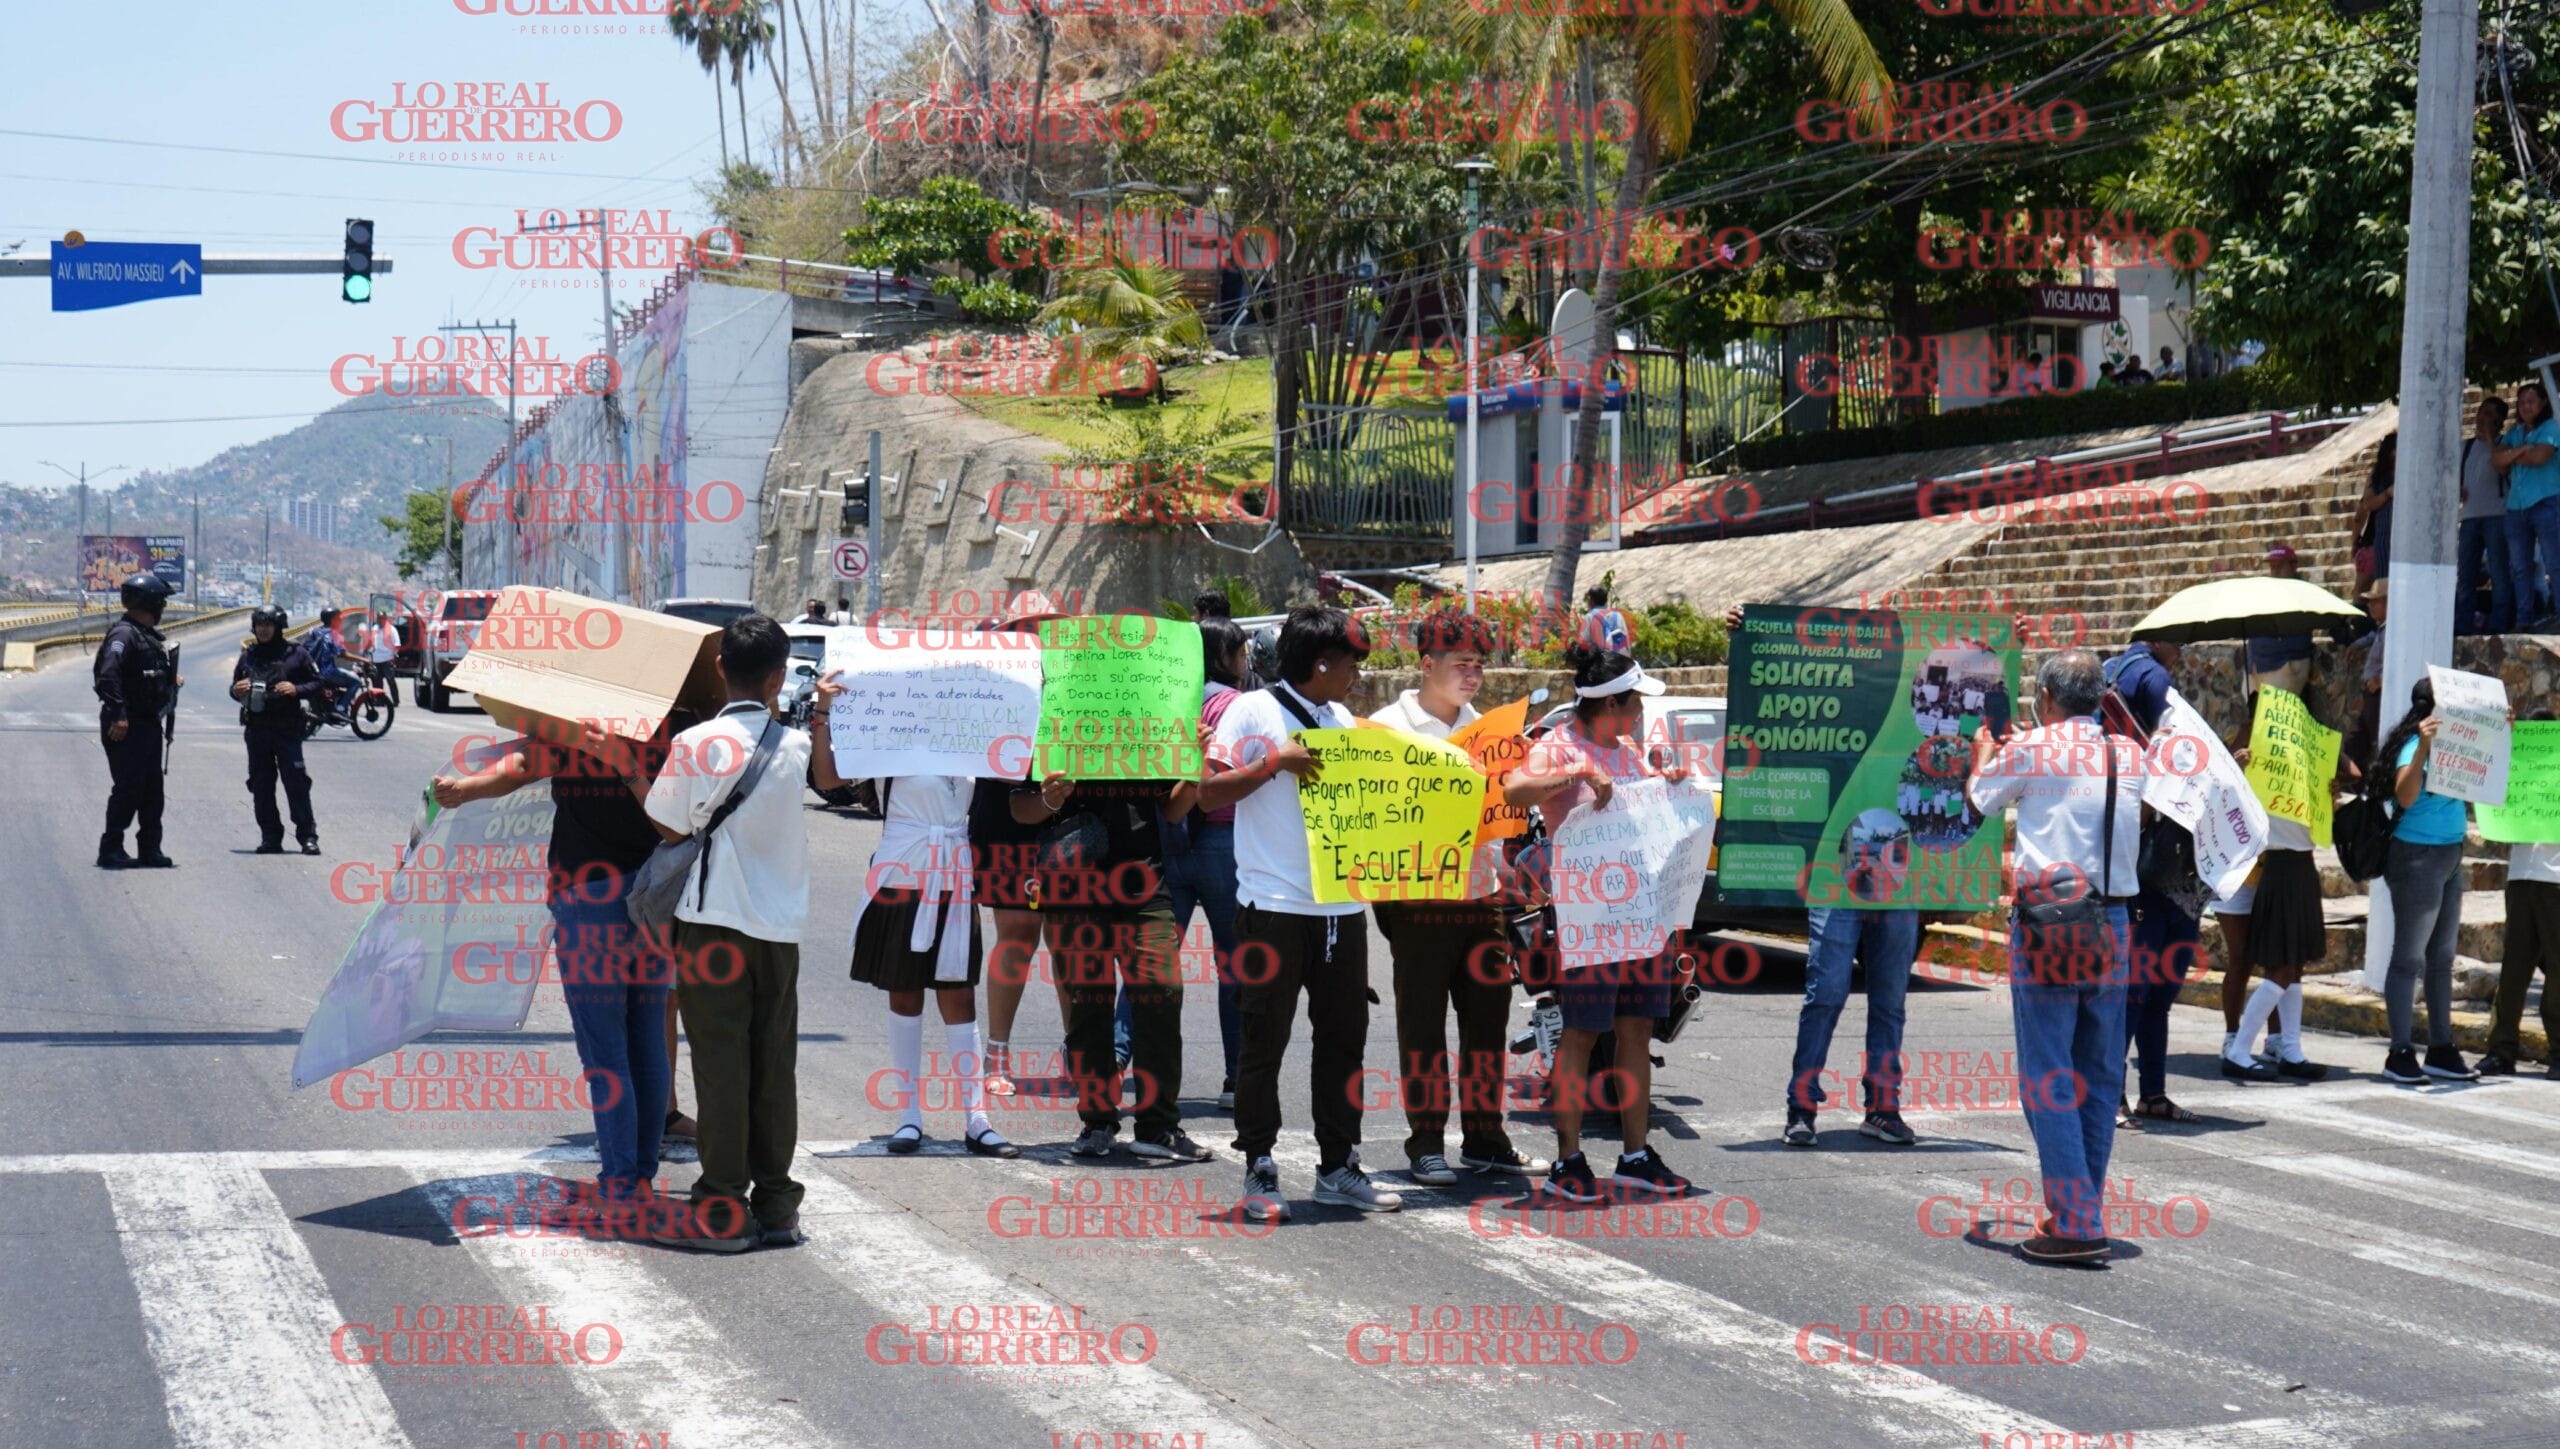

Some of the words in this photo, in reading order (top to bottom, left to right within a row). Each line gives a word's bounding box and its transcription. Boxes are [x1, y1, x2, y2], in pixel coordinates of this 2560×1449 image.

[57, 262, 74, 280] AV.
[76, 262, 122, 281] WILFRIDO
[124, 263, 164, 282] MASSIEU
[2041, 289, 2111, 313] VIGILANCIA
[1745, 620, 1793, 634] ESCUELA
[1796, 623, 1892, 639] TELESECUNDARIA
[1752, 642, 1800, 657] COLONIA
[1801, 644, 1844, 659] FUERZA
[1749, 660, 1855, 688] SOLICITA
[876, 690, 897, 704] que
[906, 687, 928, 700] las
[935, 687, 1005, 701] autoridades
[1117, 706, 1133, 718] de
[1757, 693, 1841, 721] APOYO
[1727, 720, 1867, 752] ECONÓMICO
[1404, 744, 1437, 767] Que
[1752, 772, 1765, 781] LA
[1768, 772, 1808, 783] COMPRA
[1810, 772, 1828, 784] DEL
[1358, 777, 1399, 808] para
[1406, 775, 1444, 799] que
[1449, 777, 1473, 796] no
[1738, 787, 1782, 800] TERRENO
[1784, 788, 1797, 800] DE
[1800, 789, 1812, 800] LA
[1752, 805, 1795, 817] ESCUELA
[1330, 805, 1378, 841] queden
